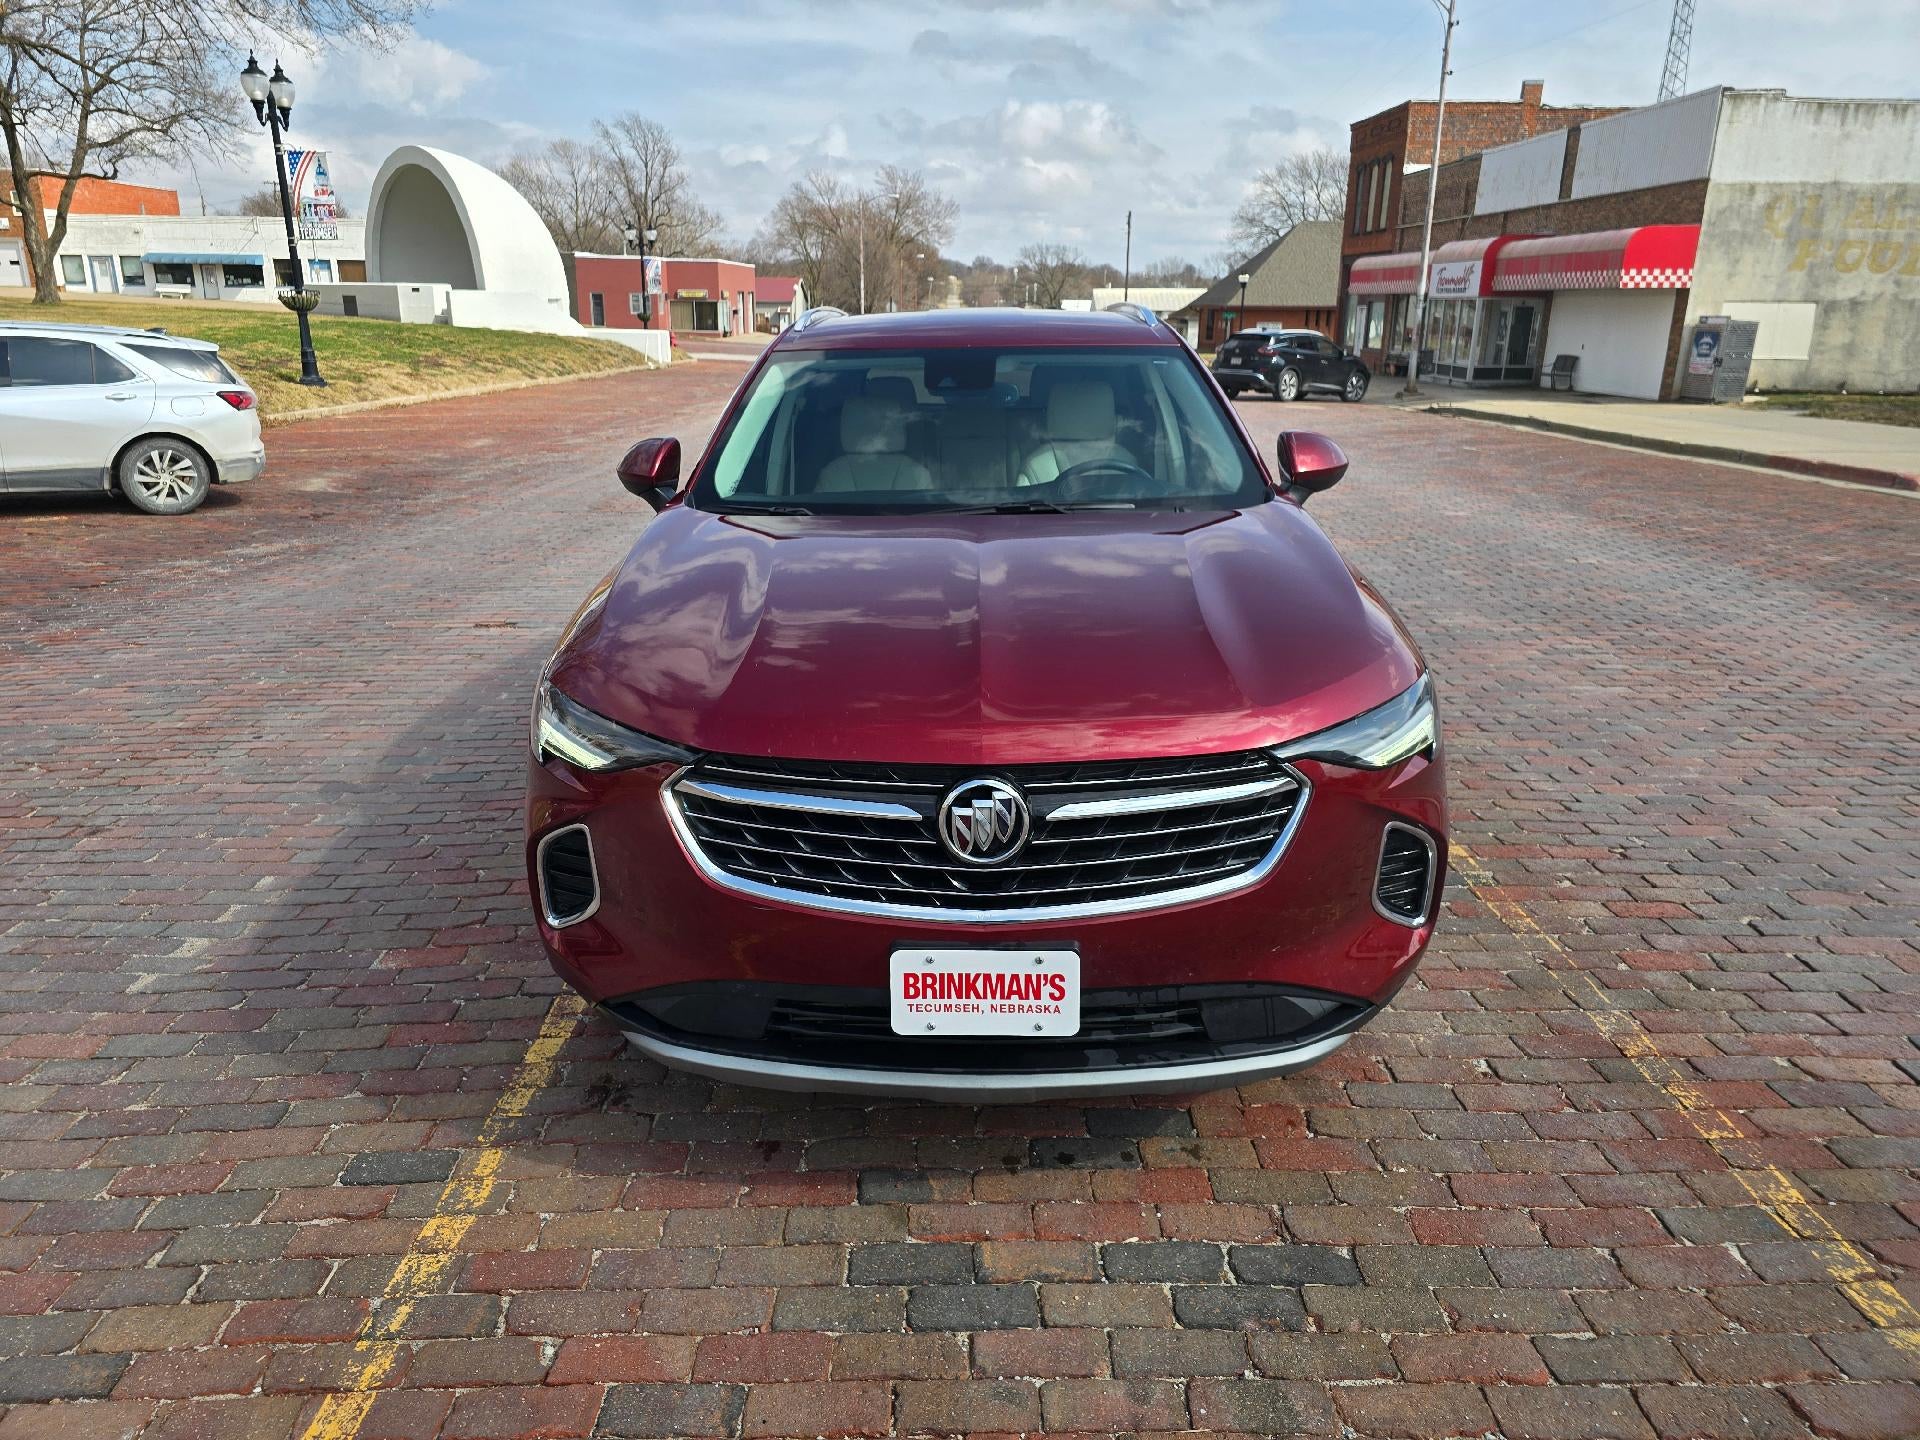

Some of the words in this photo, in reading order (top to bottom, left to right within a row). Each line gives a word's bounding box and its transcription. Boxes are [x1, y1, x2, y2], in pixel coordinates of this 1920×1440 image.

[903, 972, 1066, 1002] BRINKMAN'S
[907, 1003, 984, 1015] TECUMSEH,
[990, 1003, 1061, 1015] NEBRASKA
